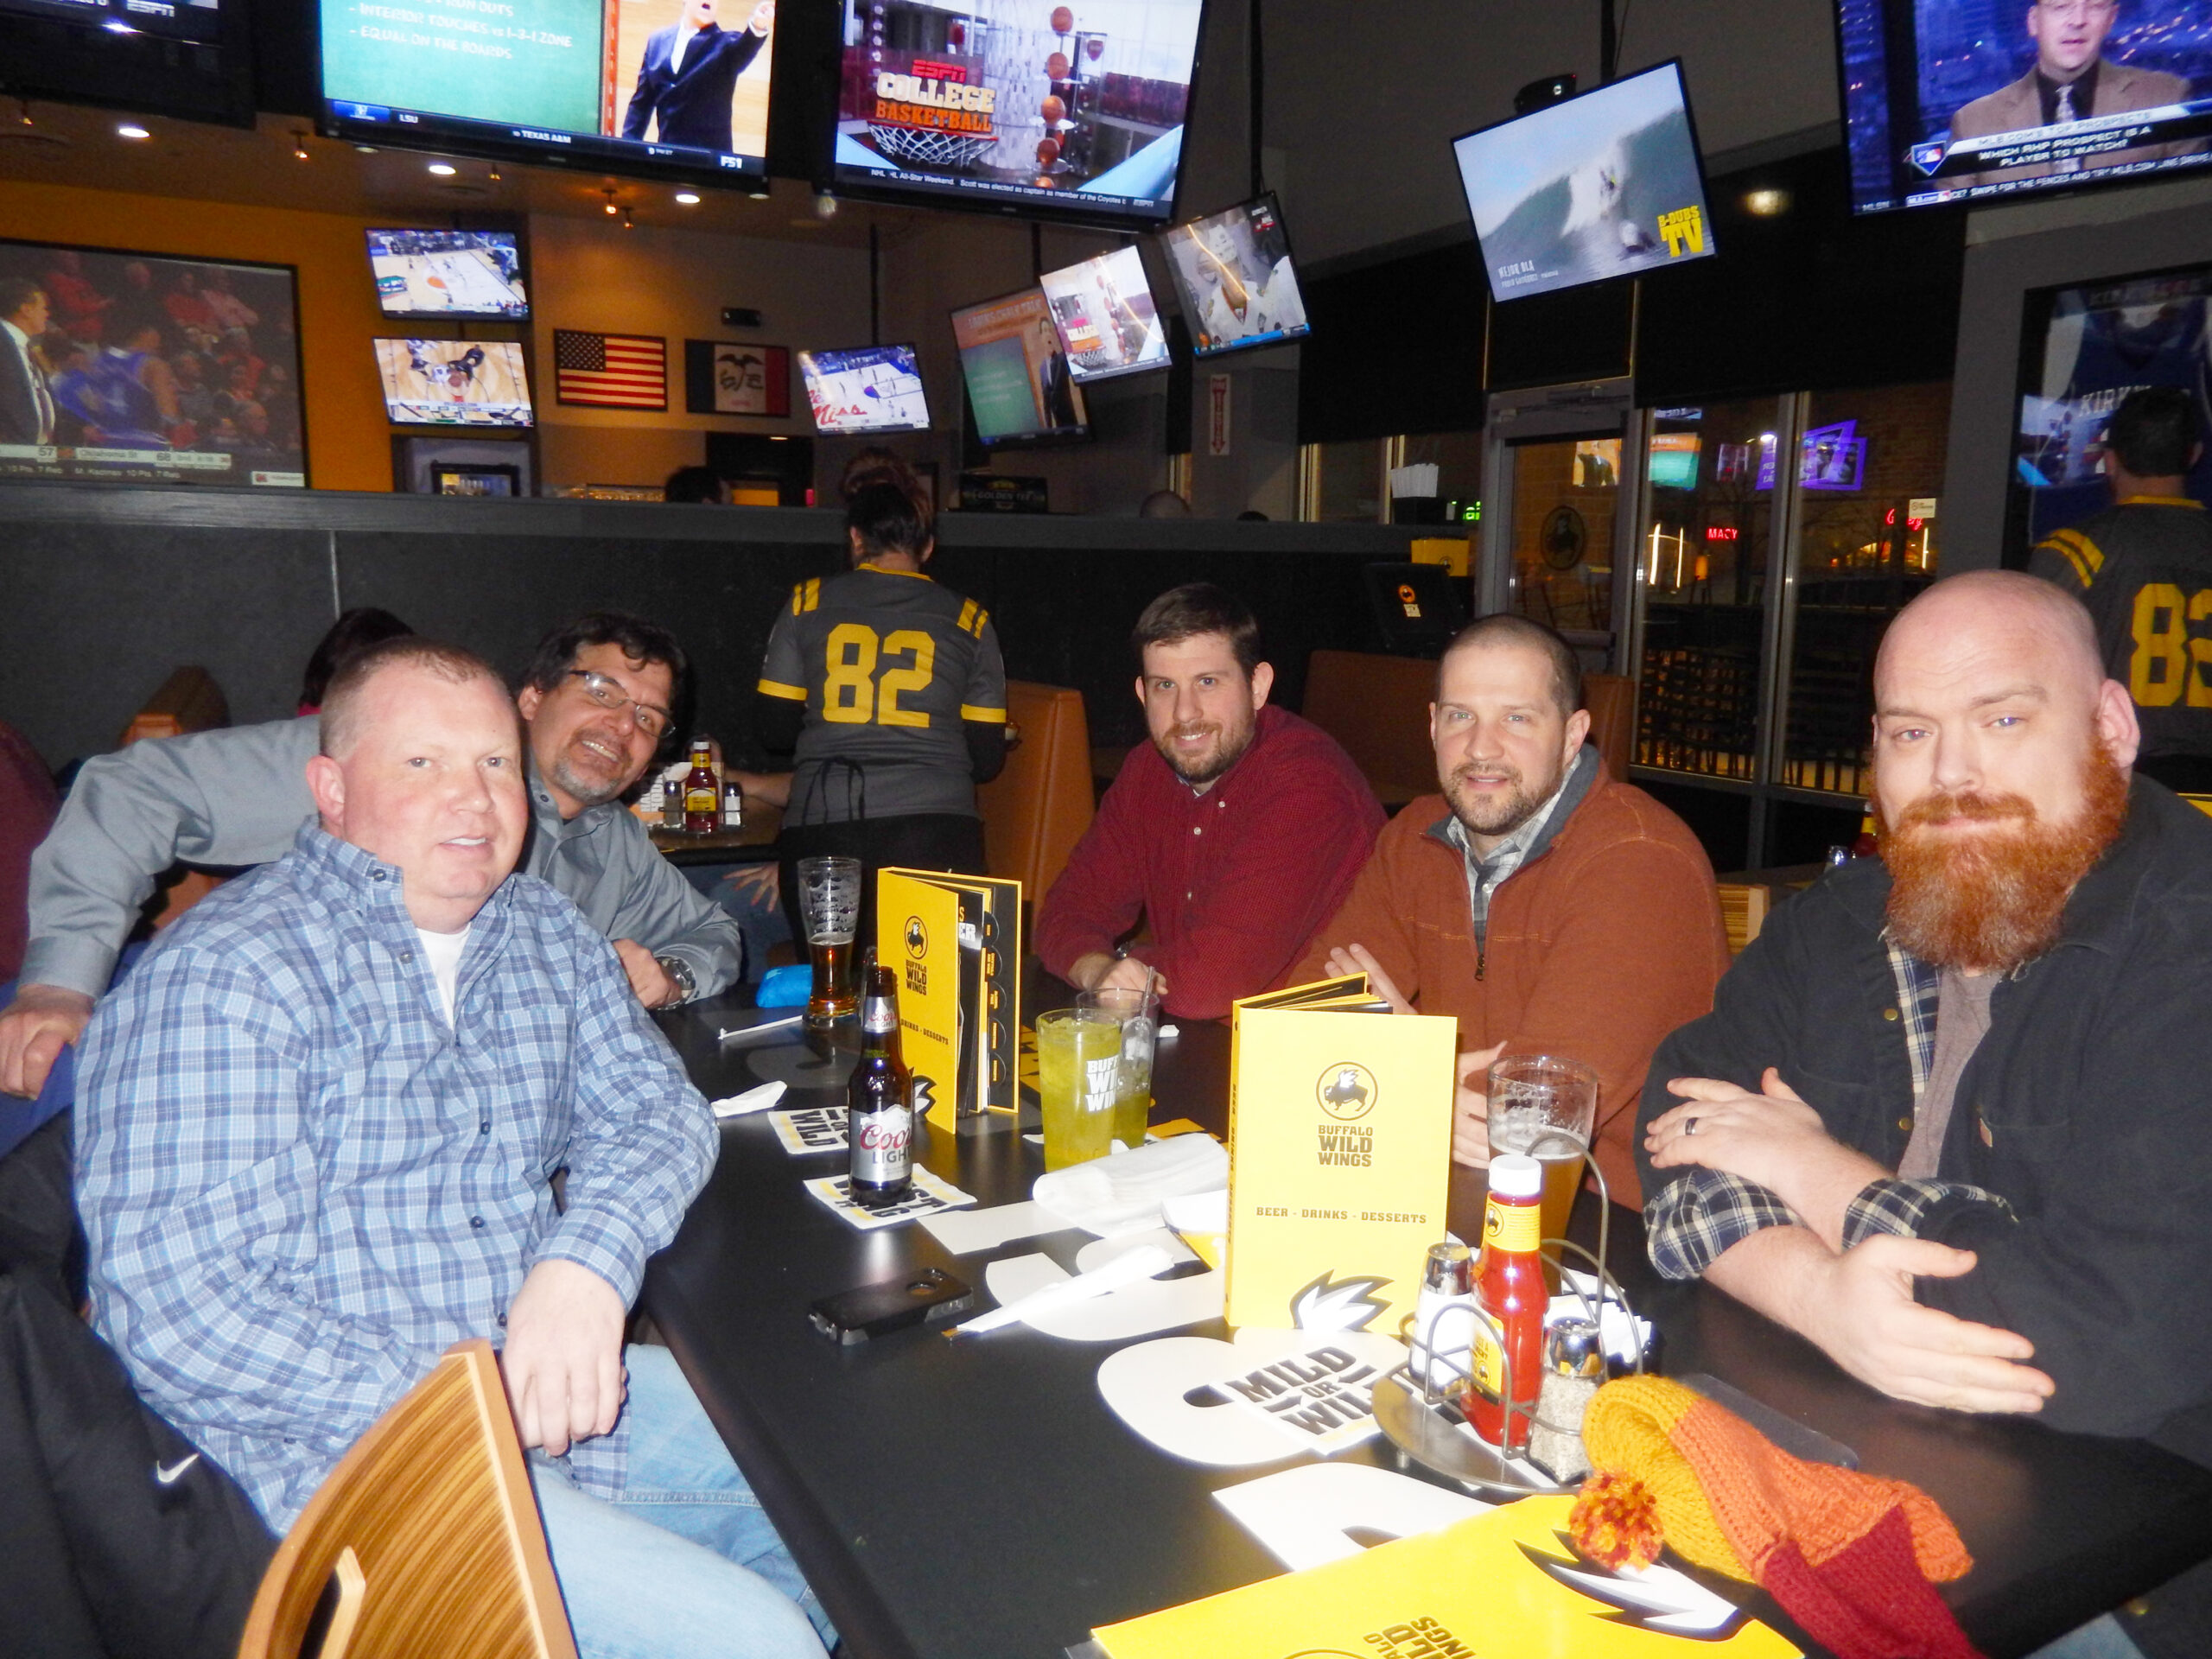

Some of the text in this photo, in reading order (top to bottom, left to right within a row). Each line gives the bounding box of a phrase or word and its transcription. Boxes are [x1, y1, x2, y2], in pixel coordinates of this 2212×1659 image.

[359, 3, 424, 23] INTERIOR
[429, 14, 488, 35] TOUCHES
[538, 31, 573, 48] ZONE
[360, 25, 513, 60] EQUAL ON THE BOARDS
[912, 59, 967, 84] ESPN
[876, 72, 995, 114] COLLEGE
[399, 114, 418, 124] LSU
[875, 99, 992, 133] BASKETBALL
[522, 130, 550, 142] TEXAS
[550, 133, 572, 144] A&M
[1979, 147, 2020, 161] WHICH
[2050, 130, 2123, 149] PROSPECT
[2139, 125, 2152, 134] A
[720, 155, 743, 168] FS1
[1999, 151, 2050, 168] PLAYER
[2053, 148, 2071, 159] TO
[1097, 195, 1122, 205] Coyotes
[1657, 205, 1700, 227] B-DUBS
[1659, 217, 1703, 258] TV
[822, 623, 935, 728] 82
[906, 959, 927, 974] BUFFALO
[906, 967, 927, 985] WILD
[906, 979, 927, 995] WINGS
[900, 1019, 949, 1046] DRINKS DESSERTS
[790, 1109, 839, 1147] WILD
[1318, 1125, 1373, 1136] BUFFALO
[1318, 1135, 1373, 1154] WILD
[1318, 1152, 1372, 1167] WINGS
[1256, 1206, 1427, 1224] BEER DRINKS DESSERTS
[1224, 1346, 1357, 1403] MILD
[1300, 1382, 1343, 1398] OR
[1279, 1382, 1379, 1436] WIL
